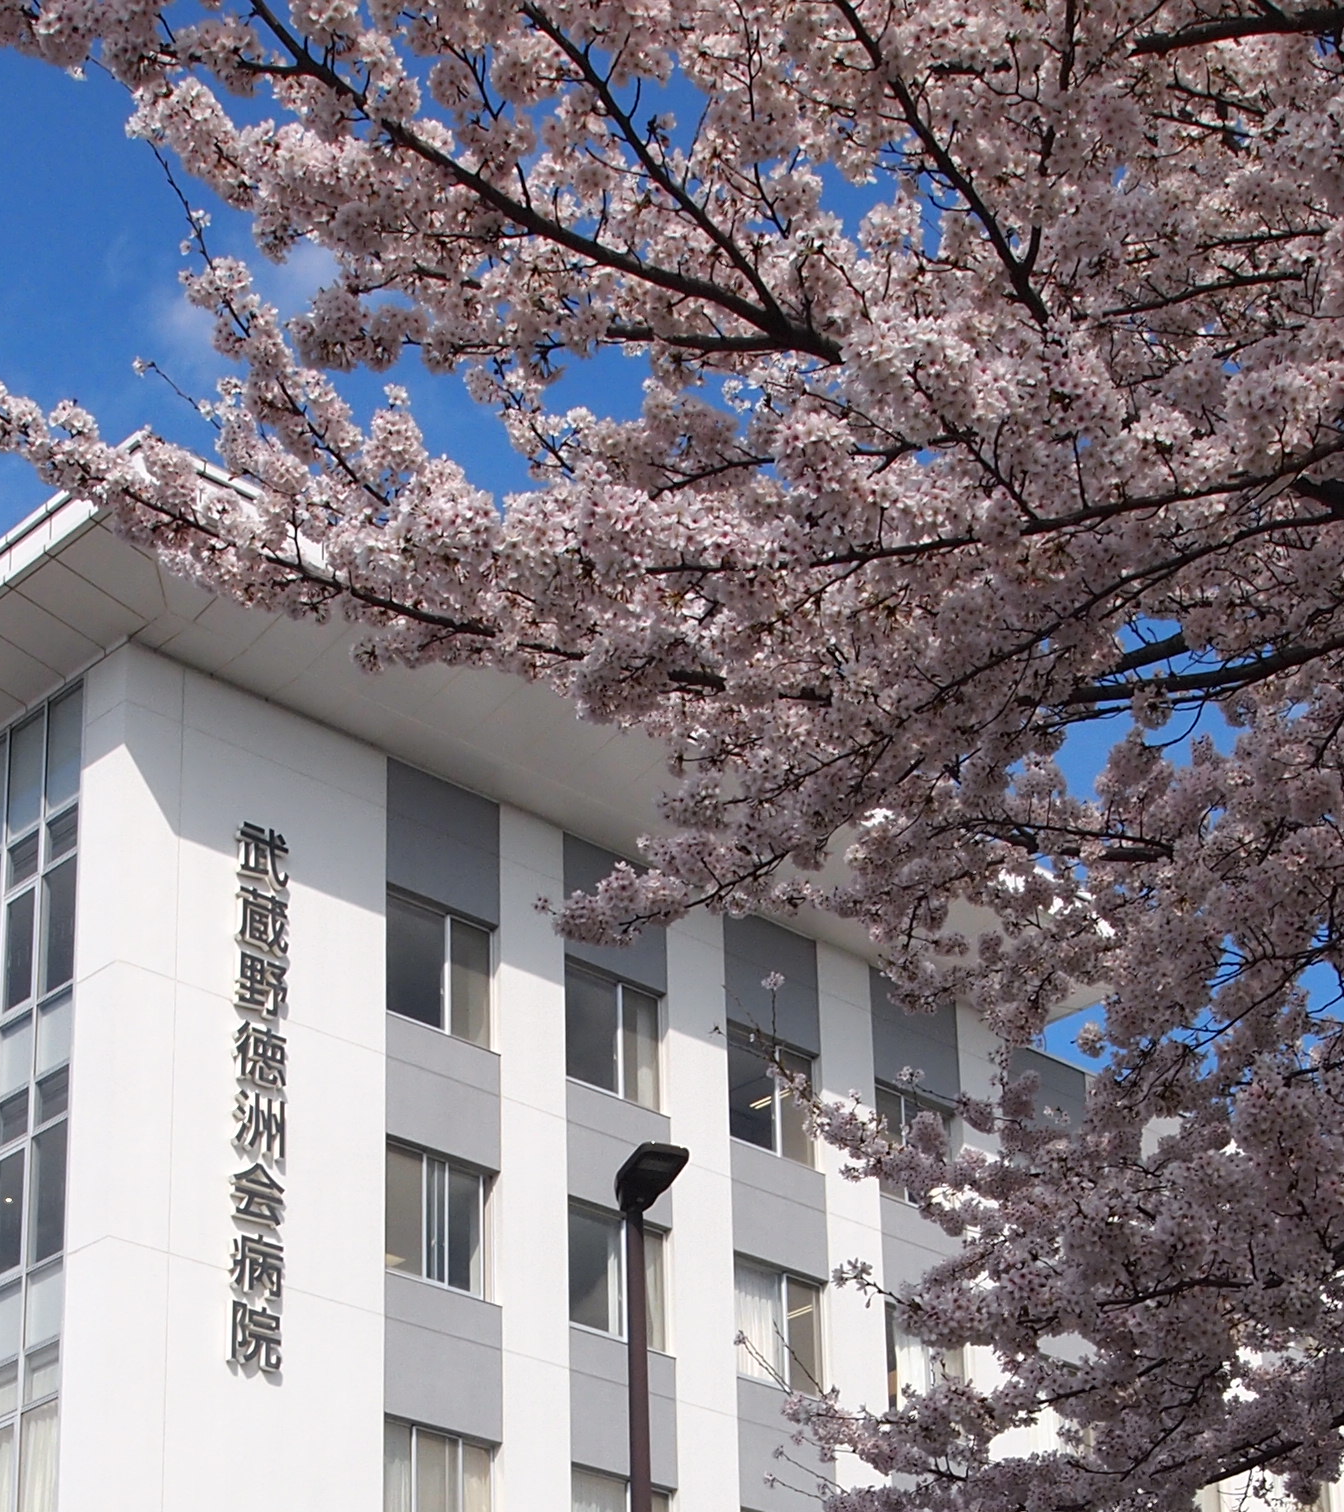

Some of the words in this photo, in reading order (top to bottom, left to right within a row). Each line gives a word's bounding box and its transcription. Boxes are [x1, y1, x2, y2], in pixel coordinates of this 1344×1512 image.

[230, 820, 289, 1374] 武蔵野徳洲会病院
